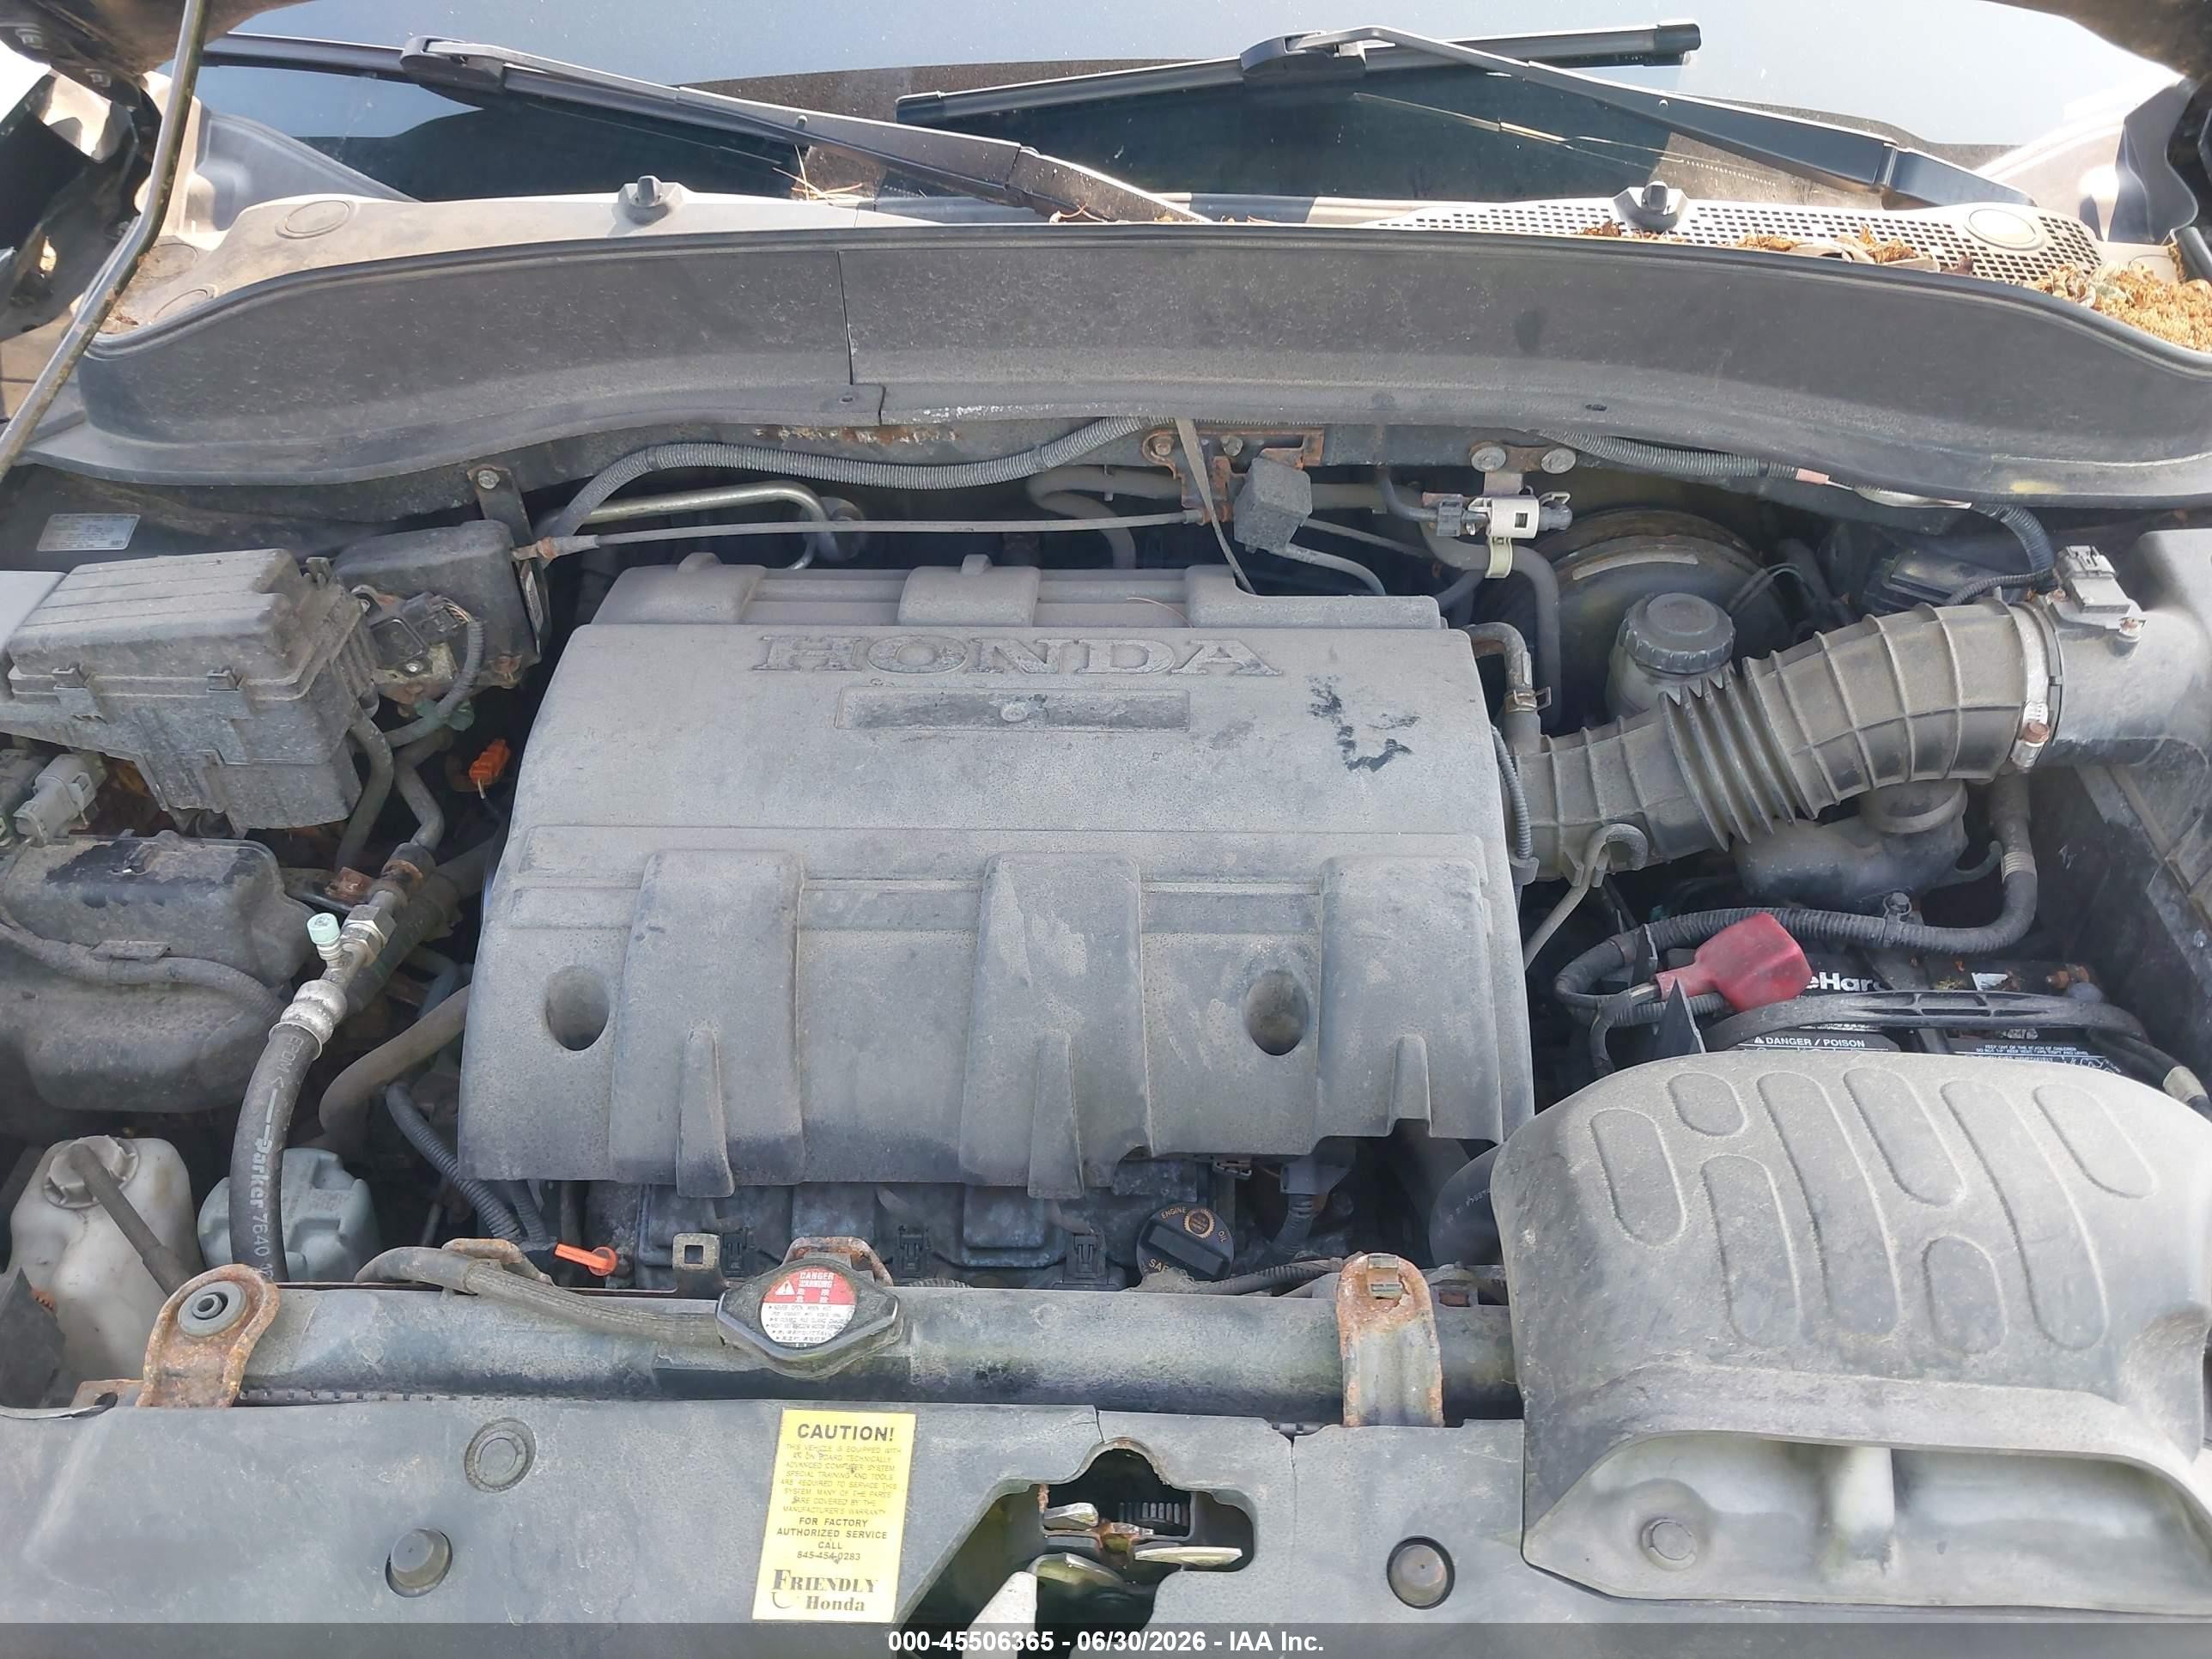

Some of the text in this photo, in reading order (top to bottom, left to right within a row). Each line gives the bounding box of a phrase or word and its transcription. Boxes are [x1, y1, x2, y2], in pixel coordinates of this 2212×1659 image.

[752, 634, 1284, 678] HONDA
[1765, 1037, 1812, 1046] DANGER
[1823, 1039, 1865, 1048] POISON
[250, 1138, 273, 1209] Parker
[1161, 1206, 1227, 1243] ENGINE OIL
[252, 1213, 270, 1256] 7640
[797, 1424, 894, 1442] CAUTION!
[824, 1518, 868, 1527] FACTORY
[776, 1528, 887, 1540] AUTHORIZED SERVICE
[797, 1551, 860, 1560] 845-454-0283
[772, 1569, 878, 1593] FRIENDLY
[805, 1595, 865, 1612] Honda
